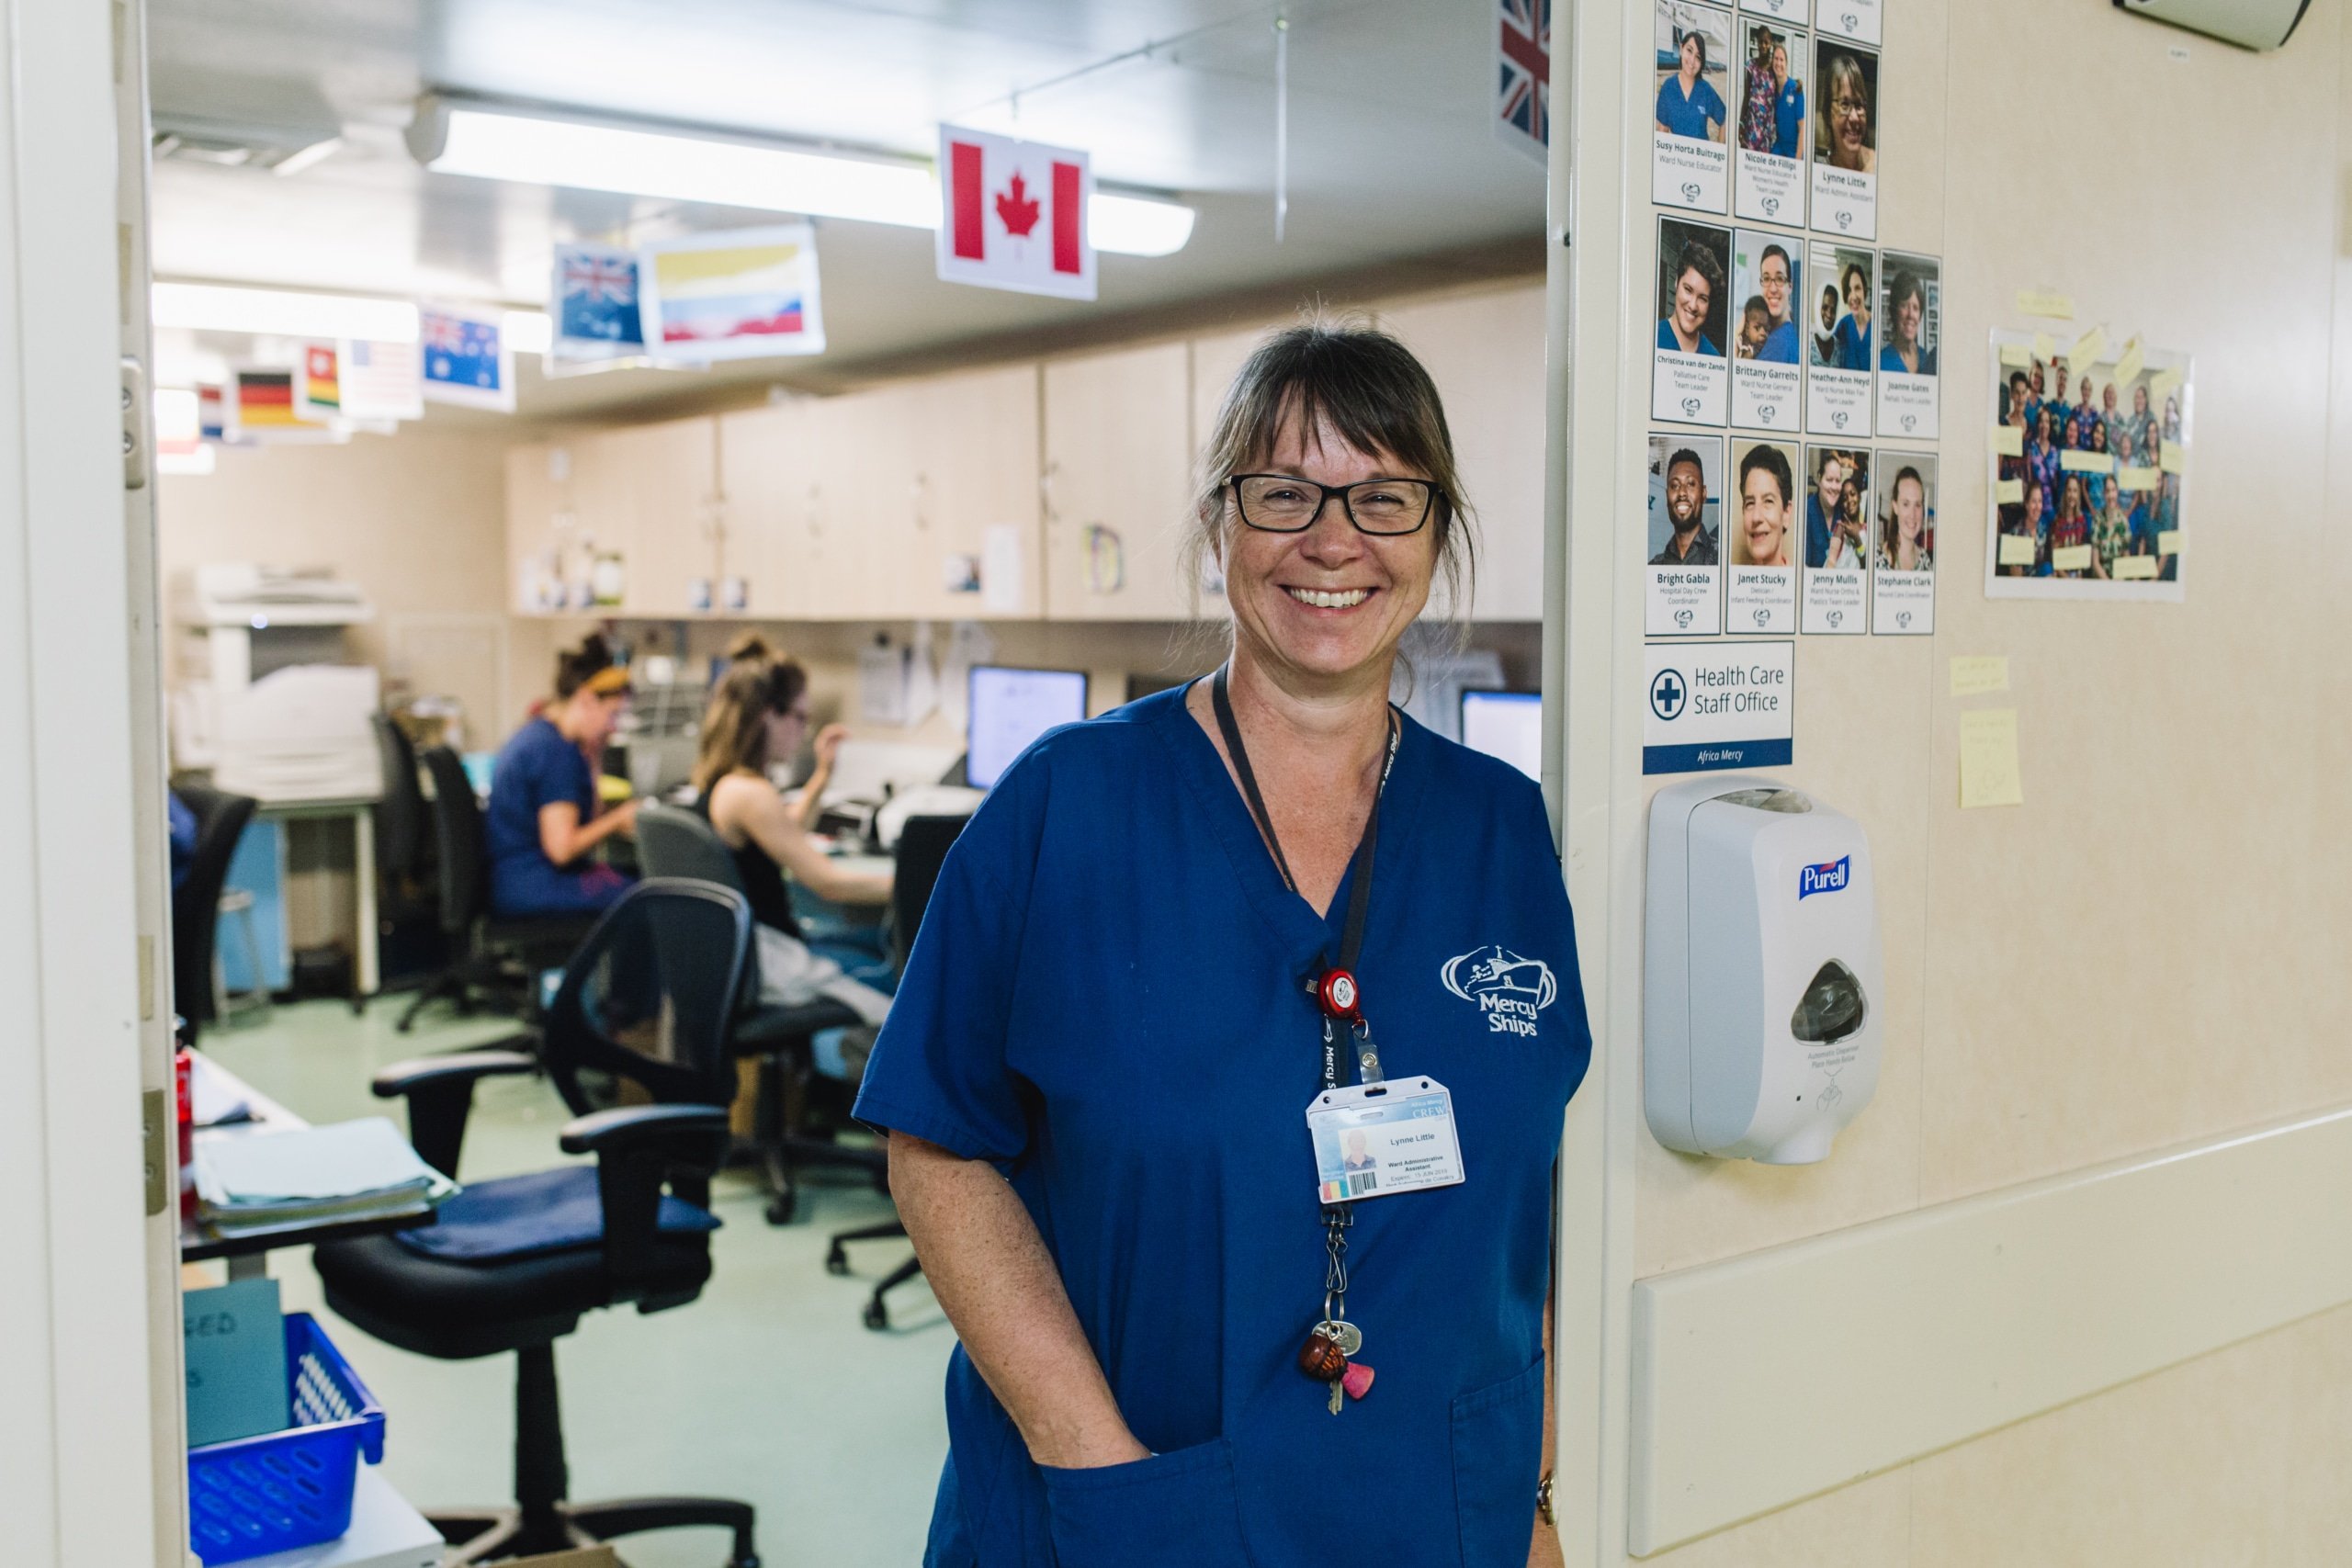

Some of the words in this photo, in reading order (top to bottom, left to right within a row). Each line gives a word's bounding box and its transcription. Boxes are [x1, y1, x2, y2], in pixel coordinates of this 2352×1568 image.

[1656, 140, 1673, 153] Susy
[1674, 142, 1694, 155] Horta
[1696, 147, 1725, 162] Buitrago
[1658, 154, 1676, 165] Ward
[1677, 157, 1695, 169] Nurse
[1696, 161, 1722, 173] Educator
[1745, 152, 1767, 164] Nicole
[1768, 157, 1777, 166] de
[1823, 171, 1846, 185] Lynne
[1847, 175, 1867, 188] Little
[1657, 355, 1685, 367] Christina
[1685, 359, 1697, 368] van
[1697, 359, 1708, 369] der
[1708, 361, 1726, 372] Zande
[1673, 369, 1697, 380] Palliative
[1697, 373, 1710, 382] Care
[1736, 365, 1767, 380] Brittany
[1769, 368, 1799, 381] Garrelts
[1810, 372, 1852, 385] Heather-Ann
[1853, 377, 1870, 388] Heyd
[1675, 380, 1690, 389] Team
[1690, 382, 1709, 392] Leader
[1740, 378, 1755, 389] Ward
[1756, 381, 1772, 390] Nurse
[1773, 382, 1792, 392] General
[1887, 381, 1910, 392] Joanne
[1911, 382, 1929, 393] Gates
[1750, 390, 1765, 400] Team
[1765, 392, 1783, 401] Leader
[1824, 396, 1838, 405] Team
[1838, 397, 1855, 406] Leader
[1657, 573, 1684, 586] Bright
[1686, 573, 1710, 584] Gabla
[1737, 573, 1758, 585] Janet
[1760, 574, 1786, 587] Stucky
[1813, 575, 1835, 586] Jenny
[1836, 574, 1858, 585] Mullis
[1877, 576, 1912, 588] Stephanie
[1914, 577, 1931, 586] Clark
[1659, 587, 1681, 595] Hospital
[1682, 587, 1692, 595] Day
[1694, 665, 1746, 687] Health
[1749, 665, 1784, 685] Care
[1694, 693, 1731, 715] Staff
[1735, 691, 1778, 712] Office
[1697, 750, 1720, 764] Africa
[1721, 749, 1743, 762] Mercy
[1804, 863, 1846, 891] Purell
[1478, 993, 1538, 1020] Mercy
[1488, 1013, 1538, 1037] Ships
[1325, 1045, 1335, 1079] Mercy
[1412, 1105, 1446, 1118] CREW
[1390, 1137, 1414, 1146] Lynne
[1415, 1133, 1435, 1142] Little
[1404, 1156, 1443, 1166] Administrative
[1405, 1164, 1430, 1172] Assistant
